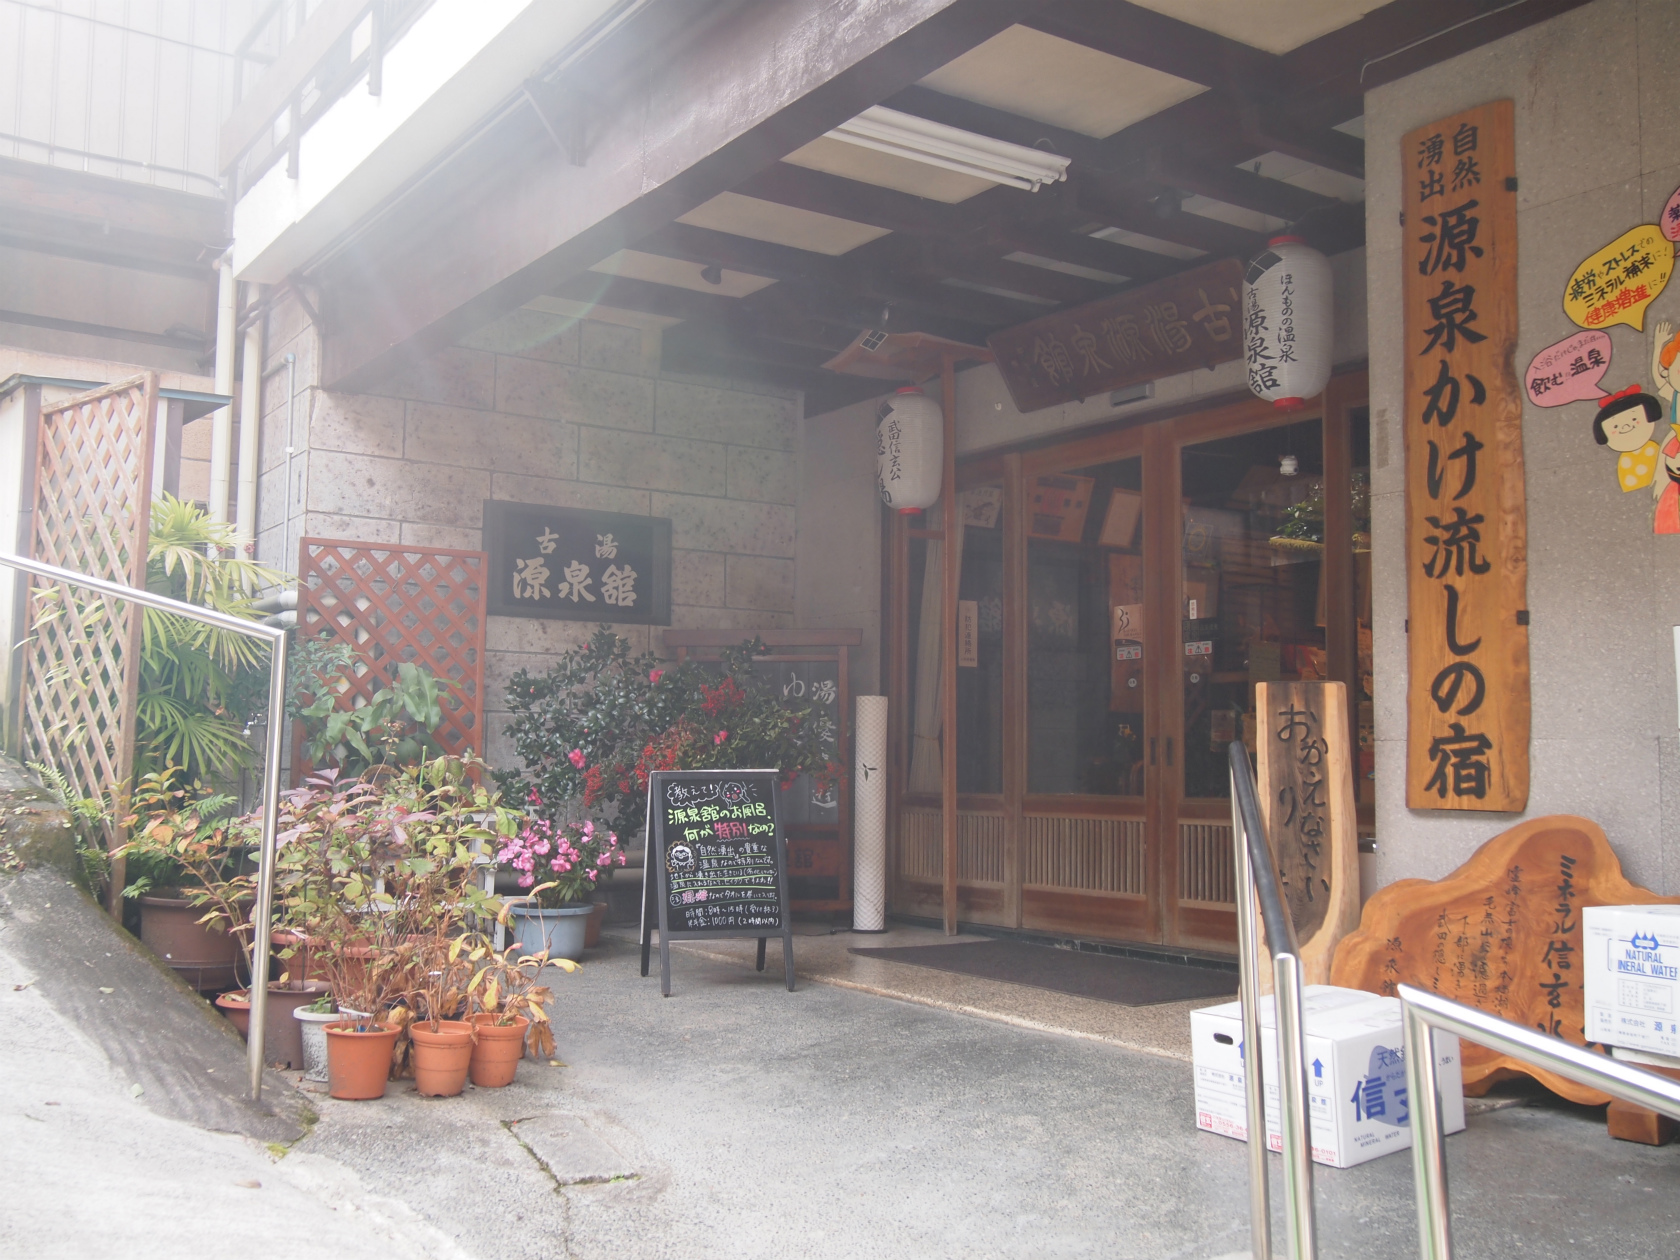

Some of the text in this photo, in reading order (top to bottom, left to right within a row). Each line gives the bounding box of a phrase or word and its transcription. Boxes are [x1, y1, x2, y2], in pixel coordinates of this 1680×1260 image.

[1417, 132, 1446, 203] 湧出
[1451, 122, 1482, 193] 自然
[1277, 273, 1299, 364] ほんものの温泉
[887, 419, 902, 481] 武田信玄公
[1417, 199, 1493, 800] 源泉かけ流しの宿
[535, 526, 619, 559] 古湯
[673, 783, 715, 801] 教えて!
[682, 821, 776, 842] 何が特別なの?
[1537, 854, 1578, 1040] ミネラル信玄水
[1625, 949, 1664, 965] NATURAL
[1617, 959, 1647, 975] INERAL
[1621, 1017, 1646, 1029] 株式会社
[1314, 1079, 1324, 1088] UP
[1354, 1131, 1376, 1143] NATURAL
[1360, 1130, 1401, 1148] MINERAL WATER
